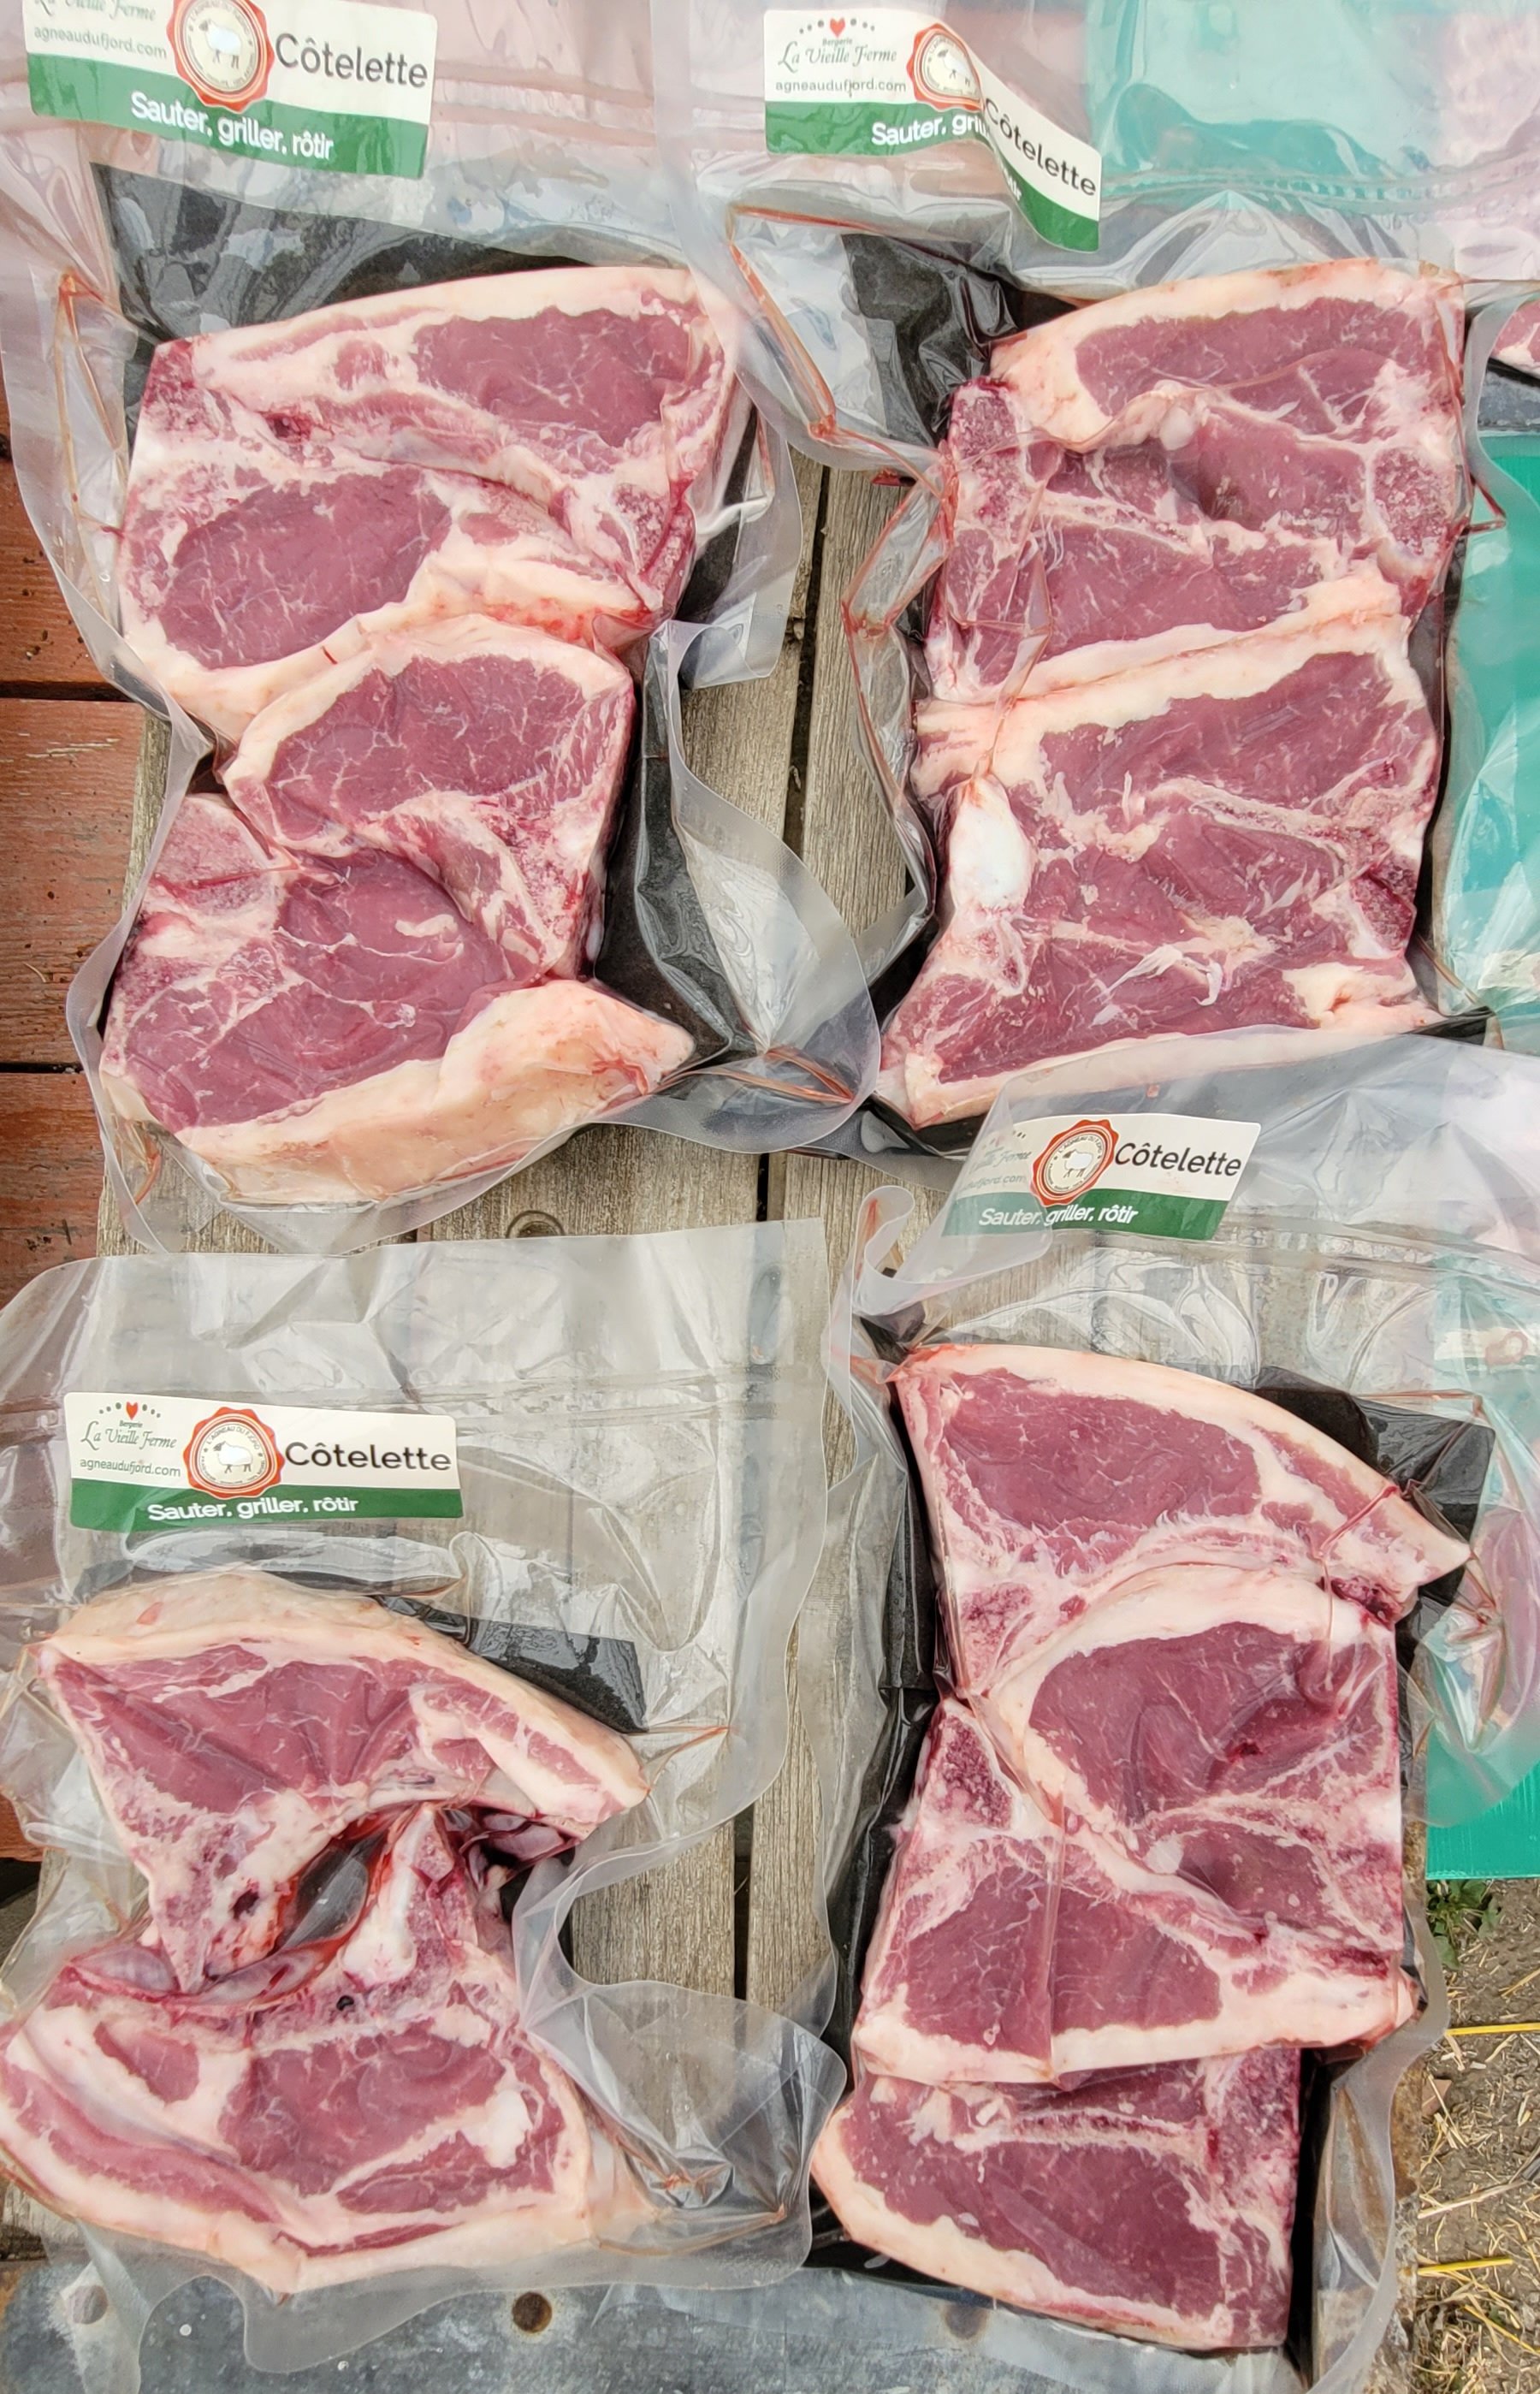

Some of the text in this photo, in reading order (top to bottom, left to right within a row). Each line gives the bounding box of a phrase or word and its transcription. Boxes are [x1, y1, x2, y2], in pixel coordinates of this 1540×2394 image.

[34, 27, 167, 58] agneaudufjord.com
[778, 40, 897, 74] La Vieille Ferme
[275, 33, 428, 88] Côtelette
[775, 78, 907, 98] agneaudufjord.com
[292, 130, 334, 160] rôtir
[986, 98, 1096, 196] Côtelette
[1115, 1142, 1241, 1176] Côtelette
[1098, 1204, 1139, 1224] rôtir
[80, 1420, 177, 1450] La Vieille Ferme
[80, 1459, 181, 1477] agneaudufjord.com
[285, 1442, 452, 1471] Côtelette
[313, 1496, 358, 1512] rôtir
